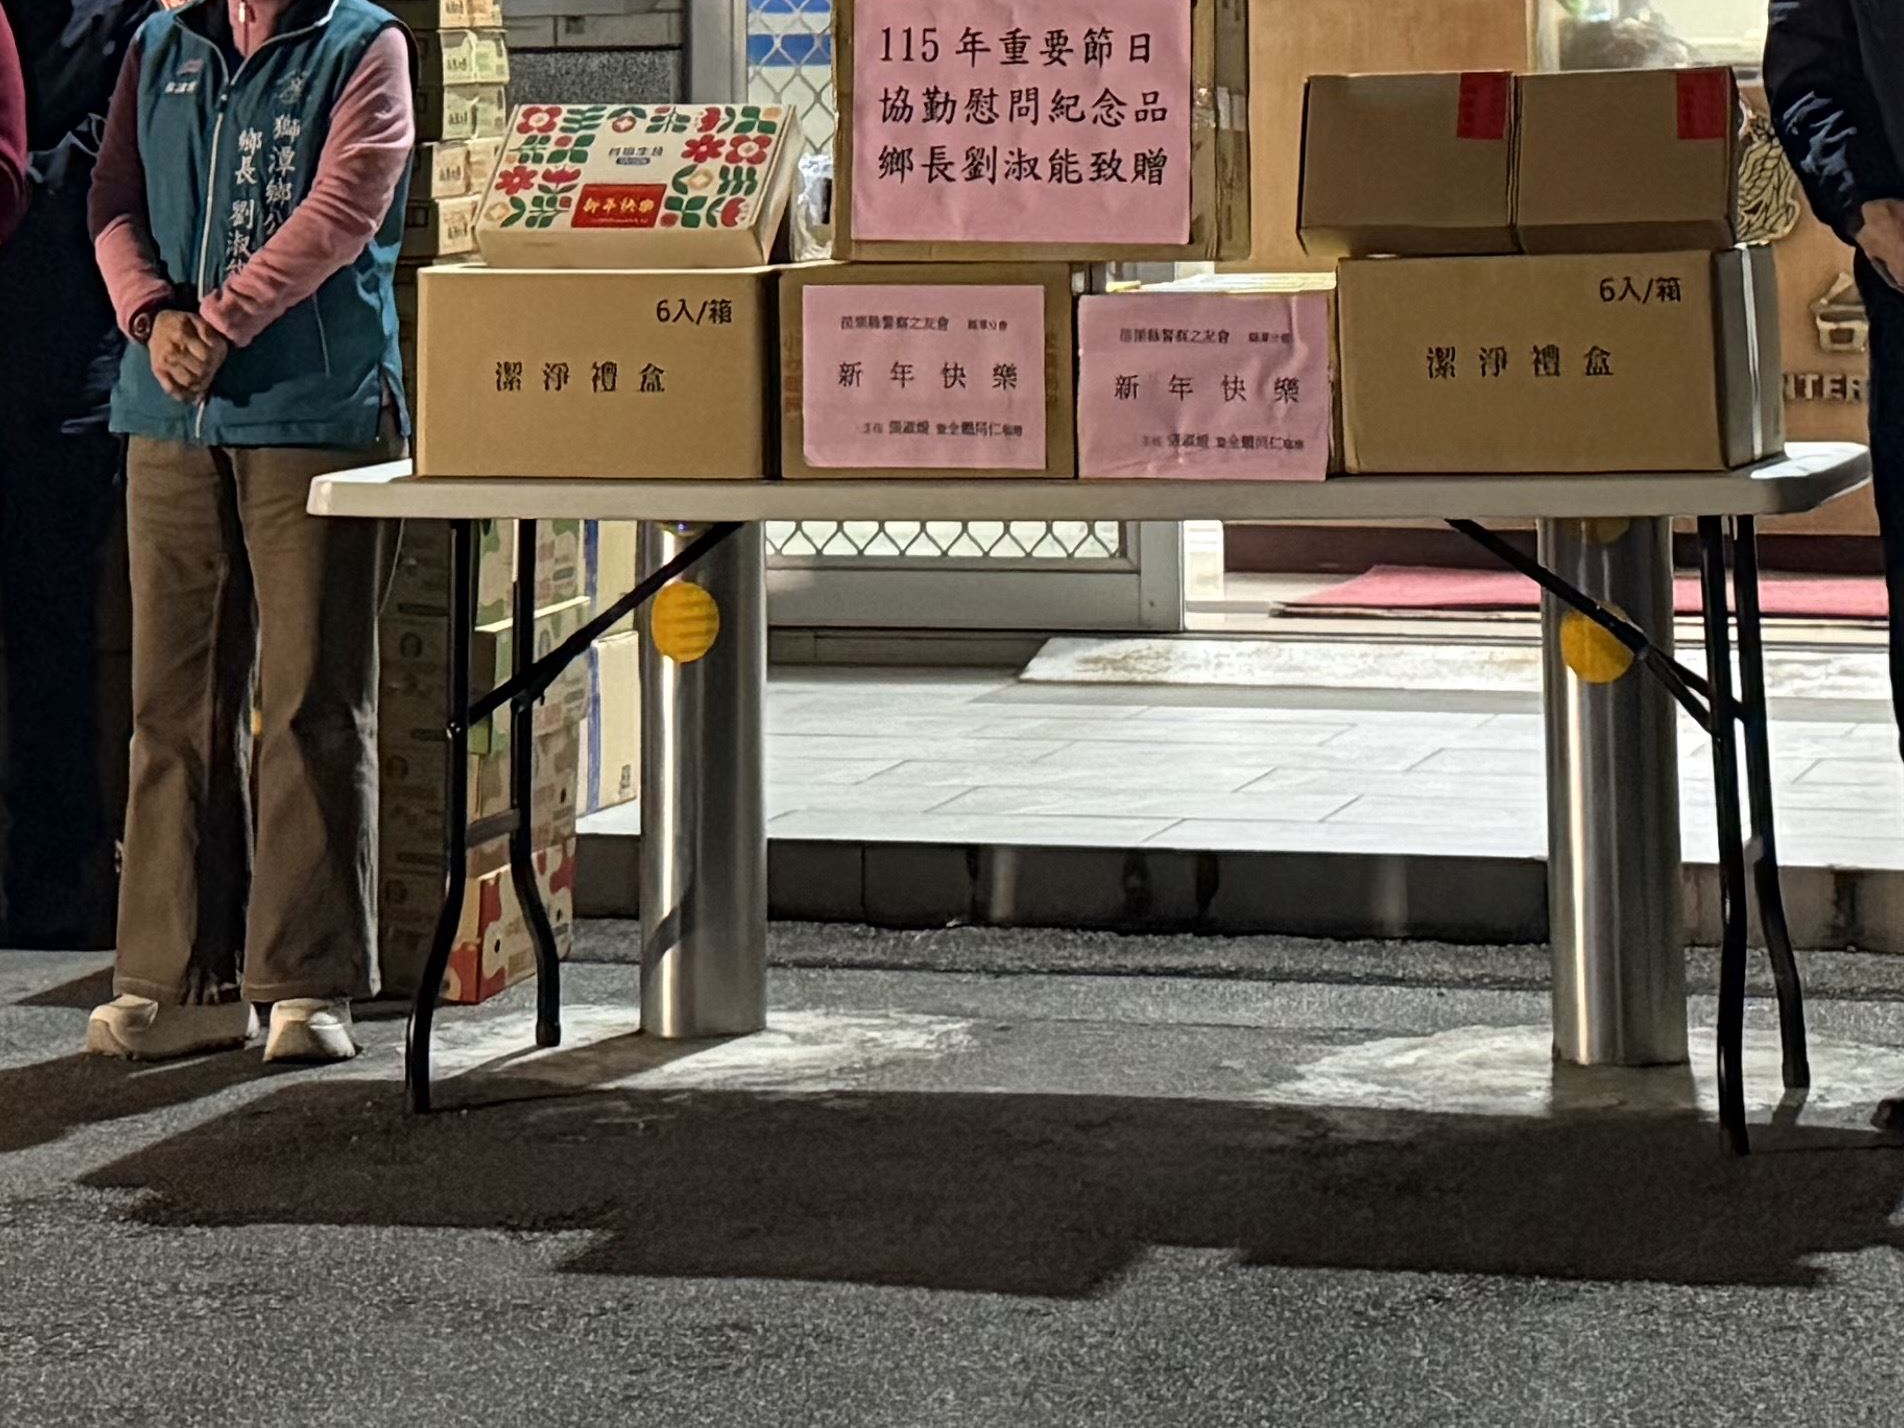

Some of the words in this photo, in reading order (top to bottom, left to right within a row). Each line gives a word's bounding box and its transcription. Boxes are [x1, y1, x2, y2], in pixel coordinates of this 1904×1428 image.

[879, 25, 1153, 69] 115年重要節日
[878, 84, 1169, 128] 協勤慰問紀念品
[877, 144, 1169, 187] 鄉長劉淑能致贈
[1599, 276, 1682, 304] 6入/箱
[655, 298, 733, 326] 6入/箱
[495, 360, 666, 393] 潔淨禮盒
[837, 360, 1019, 391] 新年快樂
[1426, 345, 1615, 380] 潔淨禮盒
[1113, 373, 1301, 404] 新年快樂
